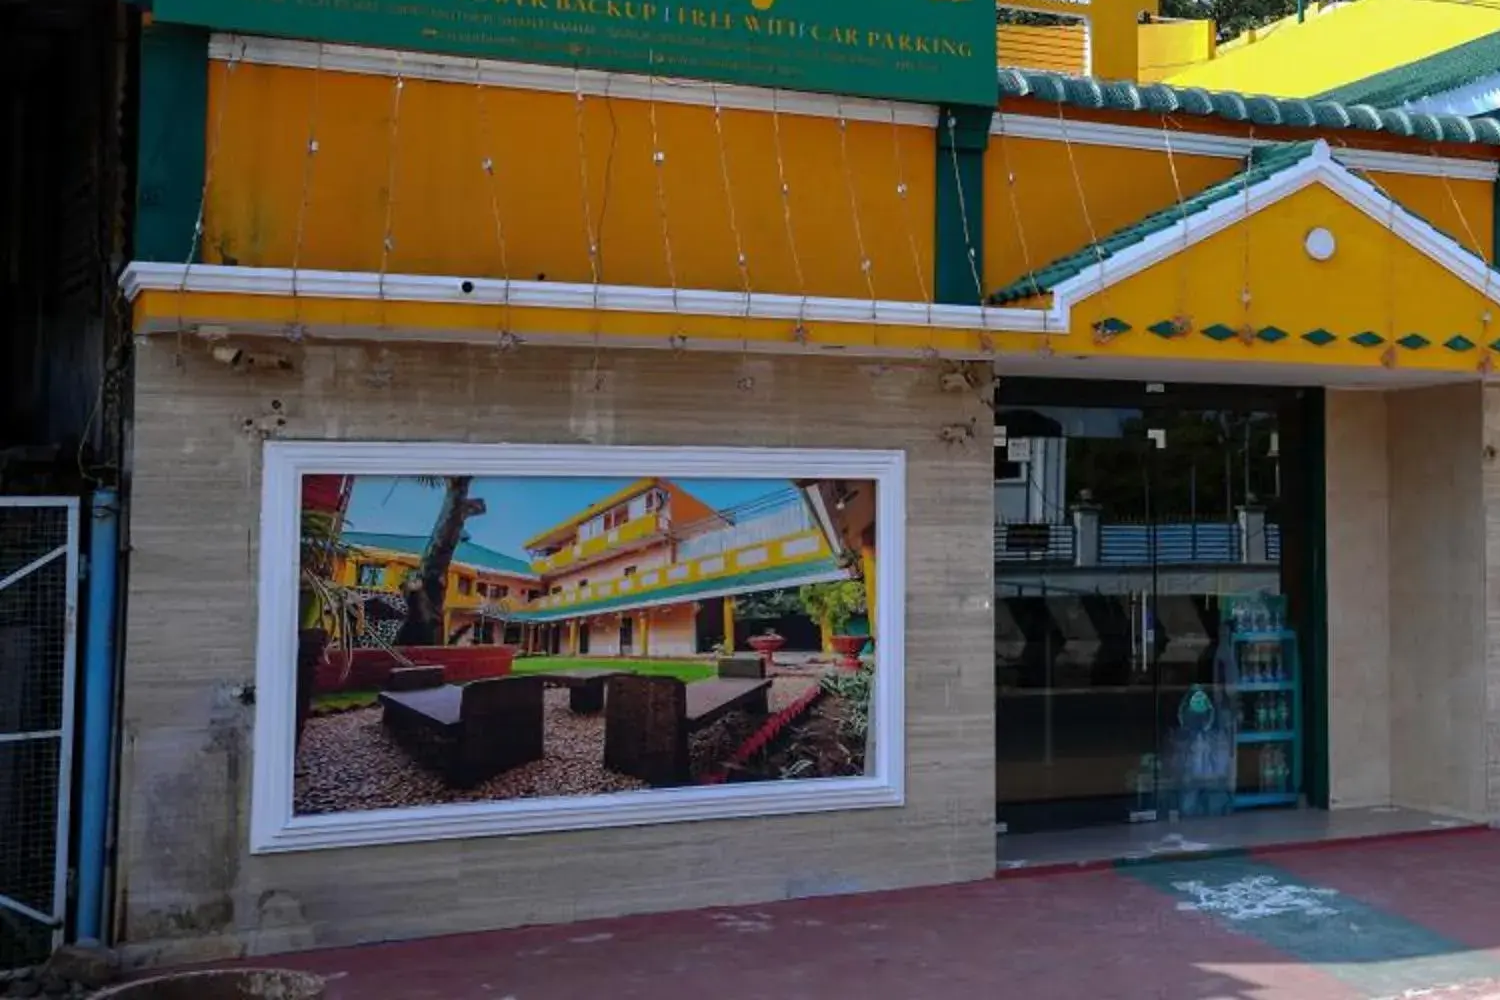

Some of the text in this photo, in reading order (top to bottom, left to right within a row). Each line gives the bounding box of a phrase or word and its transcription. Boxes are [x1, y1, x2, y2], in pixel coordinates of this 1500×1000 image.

[678, 6, 736, 30] FREE
[812, 20, 860, 45] CAR
[867, 29, 973, 58] PARKING
